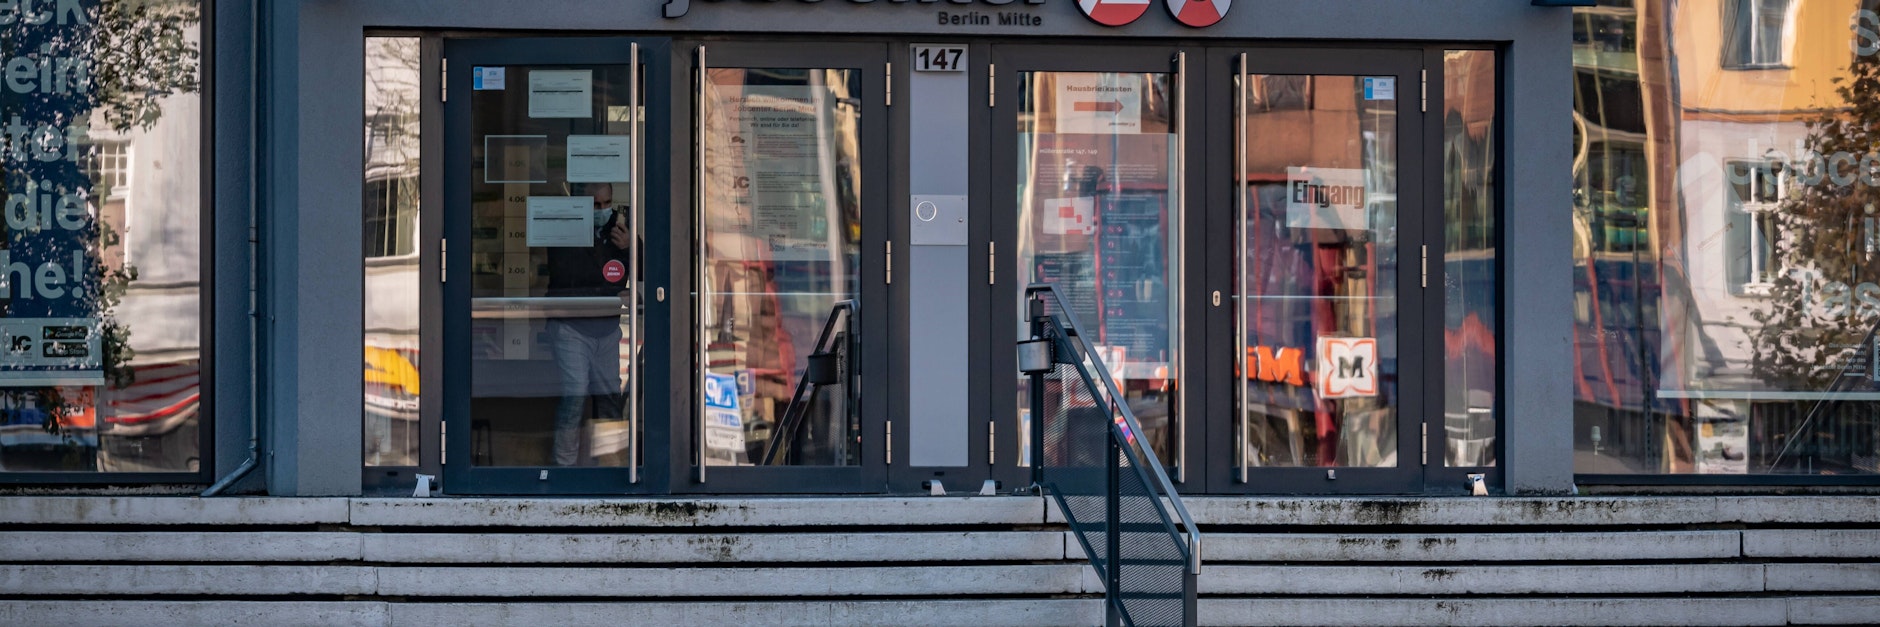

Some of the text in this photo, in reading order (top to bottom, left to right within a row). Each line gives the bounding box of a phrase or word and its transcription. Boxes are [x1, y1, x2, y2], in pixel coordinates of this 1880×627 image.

[938, 12, 1042, 26] Berlin Mitte
[5, 42, 88, 94] ein
[919, 48, 963, 70] 147
[6, 116, 89, 163] ter
[4, 180, 88, 231] die
[1292, 180, 1365, 209] Eingang
[0, 250, 84, 299] he!
[1338, 355, 1364, 379] M
